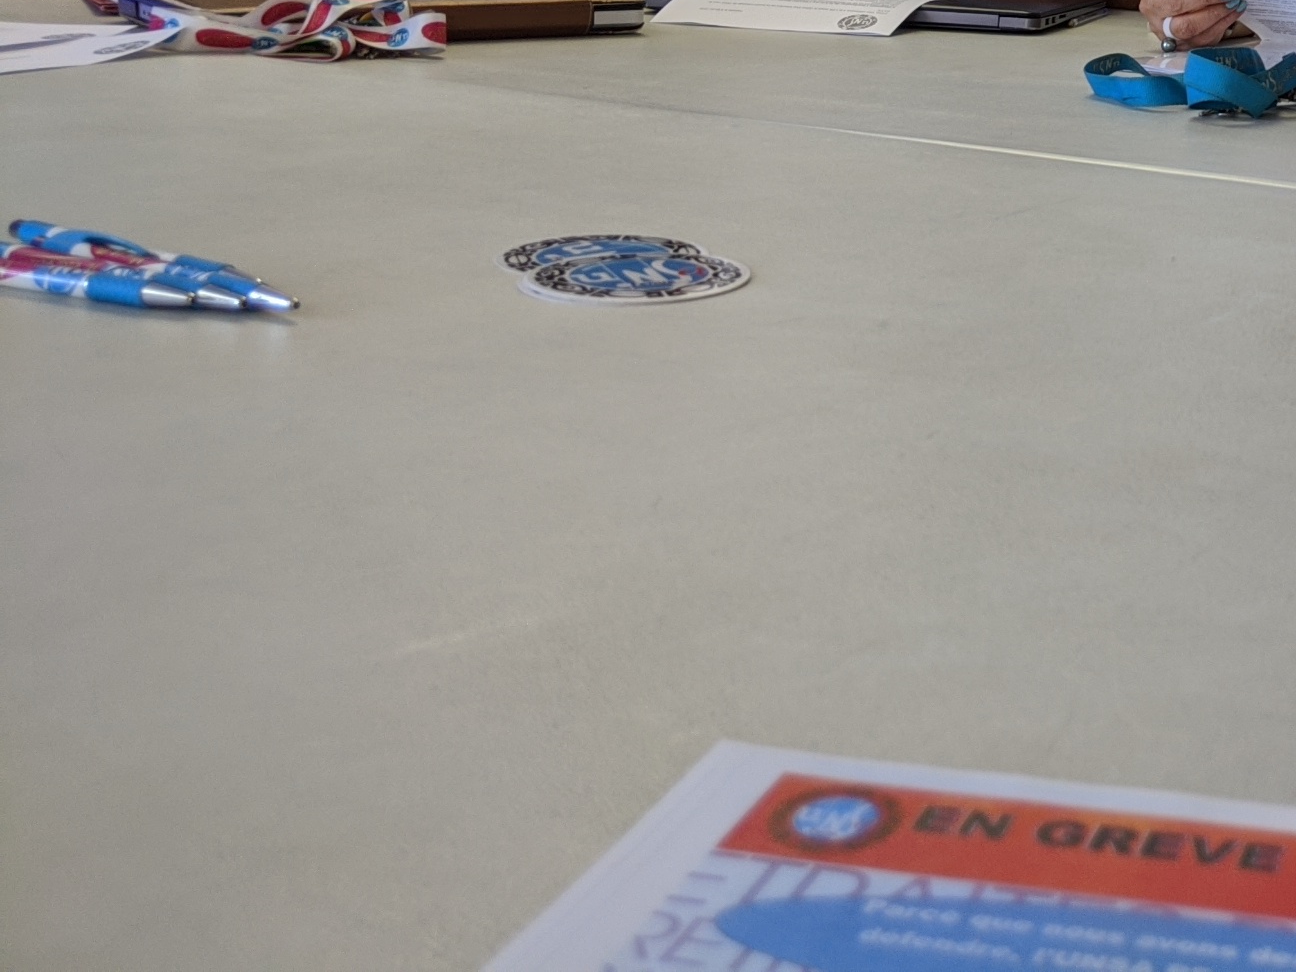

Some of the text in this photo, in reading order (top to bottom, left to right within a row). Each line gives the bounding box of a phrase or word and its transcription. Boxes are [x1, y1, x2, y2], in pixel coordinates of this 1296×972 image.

[912, 803, 1014, 841] EN
[1034, 820, 1284, 874] GREVE
[860, 895, 963, 927] Parce
[967, 912, 1036, 939] que
